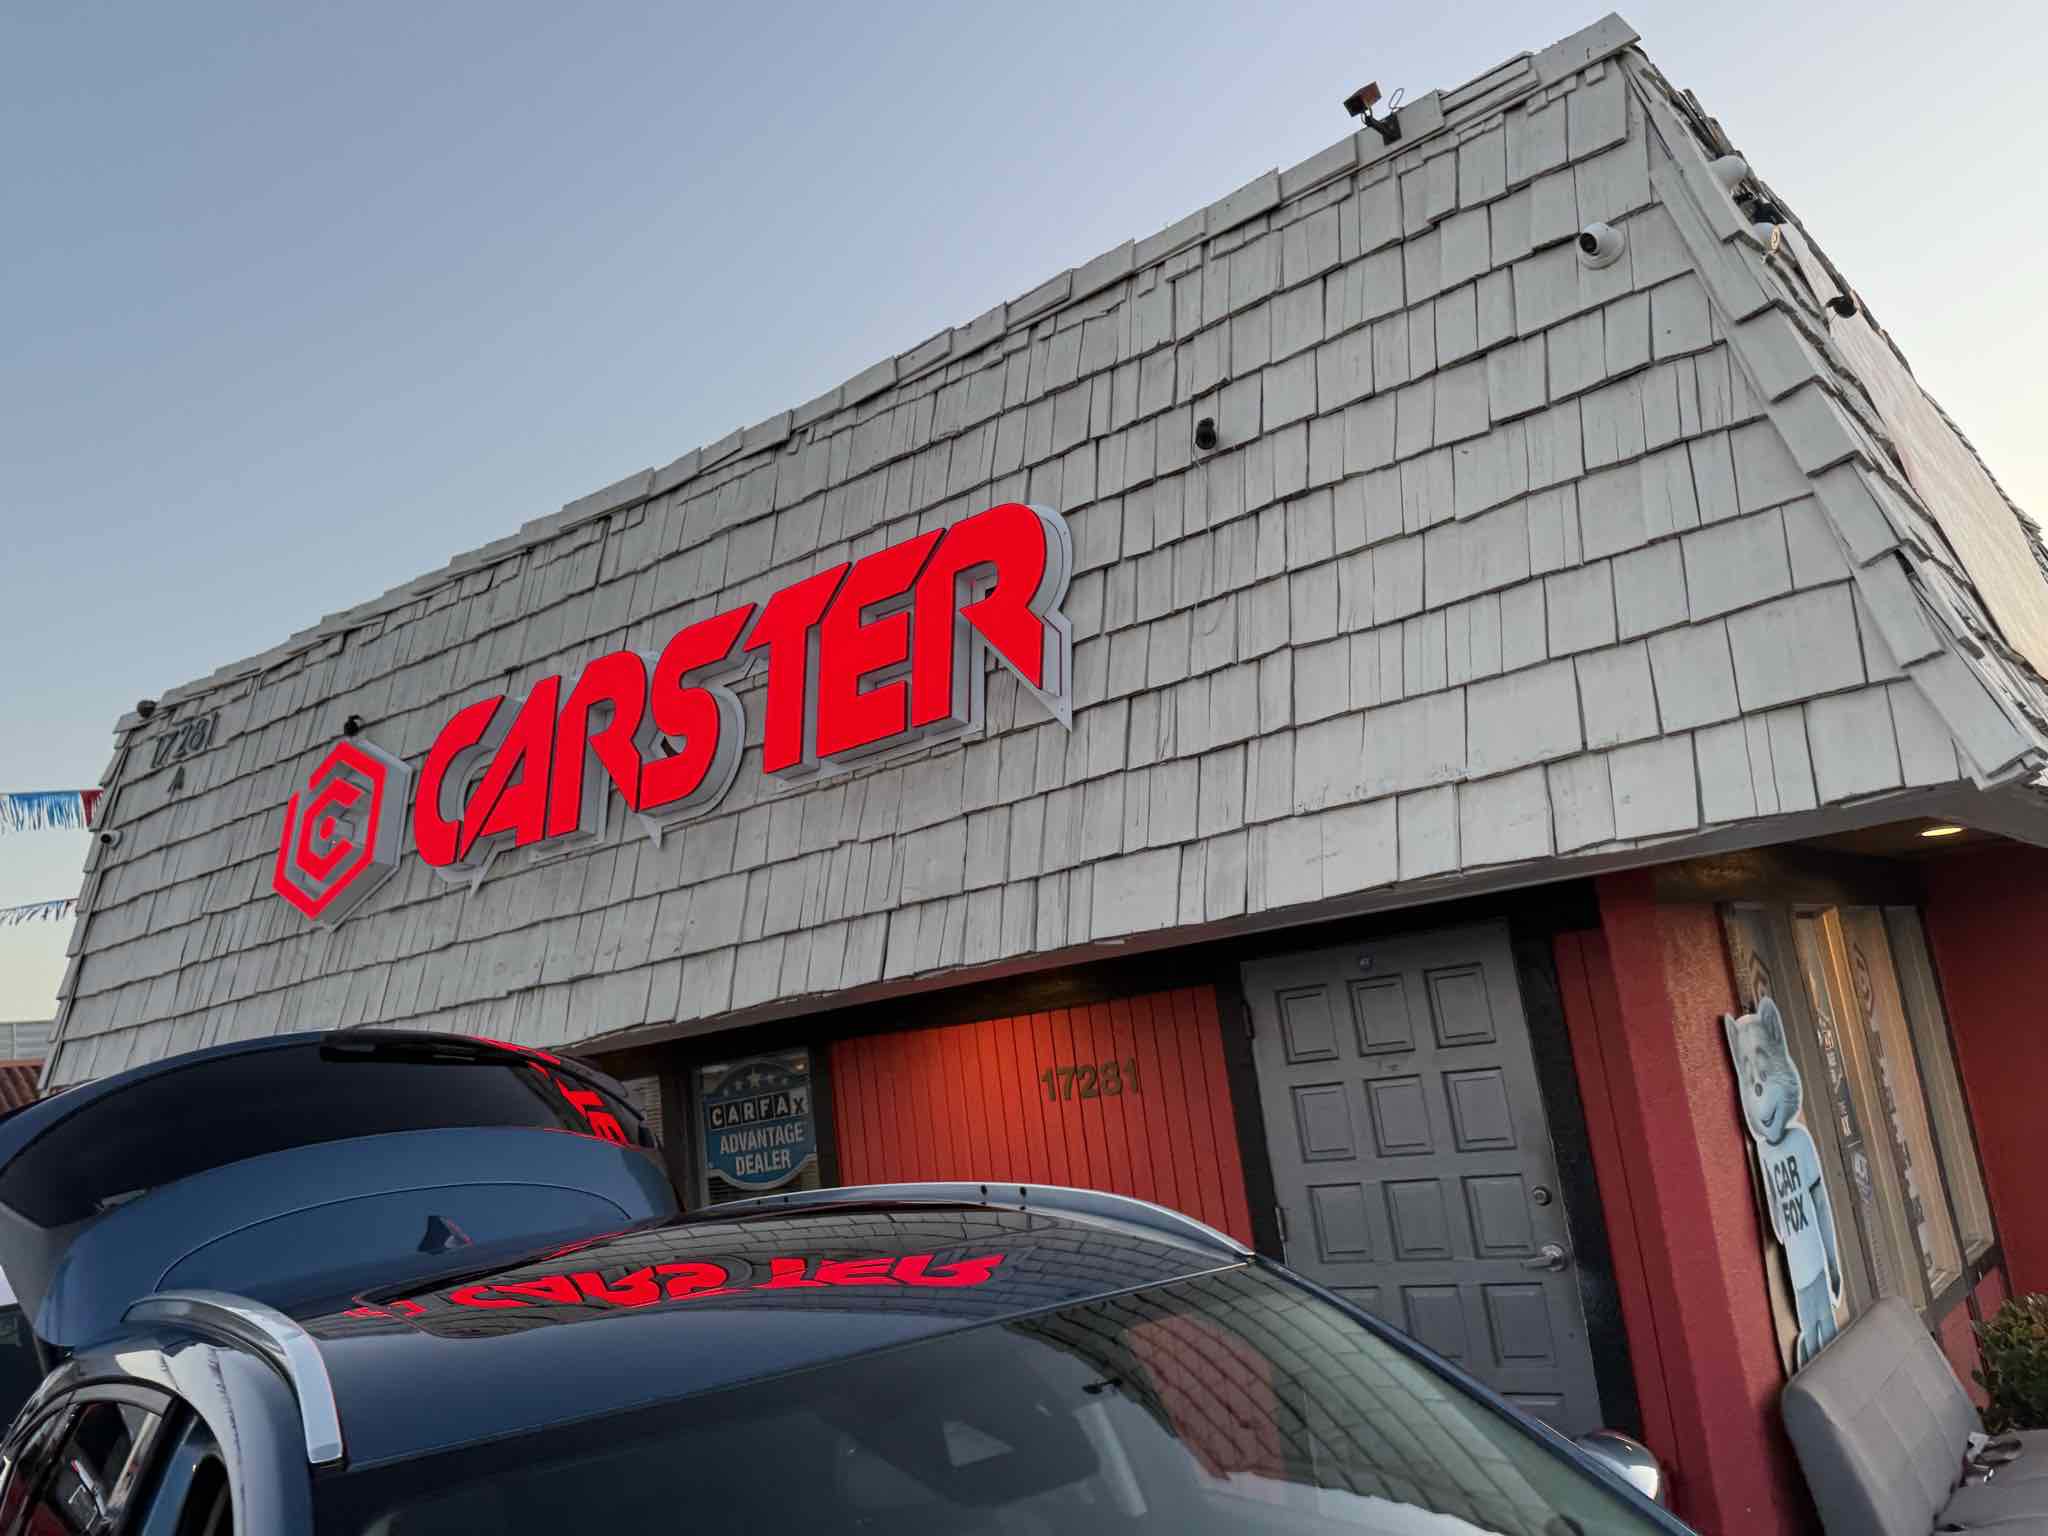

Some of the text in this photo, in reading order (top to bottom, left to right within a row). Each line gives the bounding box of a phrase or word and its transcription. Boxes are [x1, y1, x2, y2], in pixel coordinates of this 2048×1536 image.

[413, 502, 1052, 866] CARSTER
[1041, 1057, 1138, 1101] 17281
[720, 1121, 804, 1154] ADVANTAGE
[735, 1148, 791, 1177] DEALER
[1773, 1154, 1801, 1199] CAR
[1782, 1194, 1809, 1236] FOX
